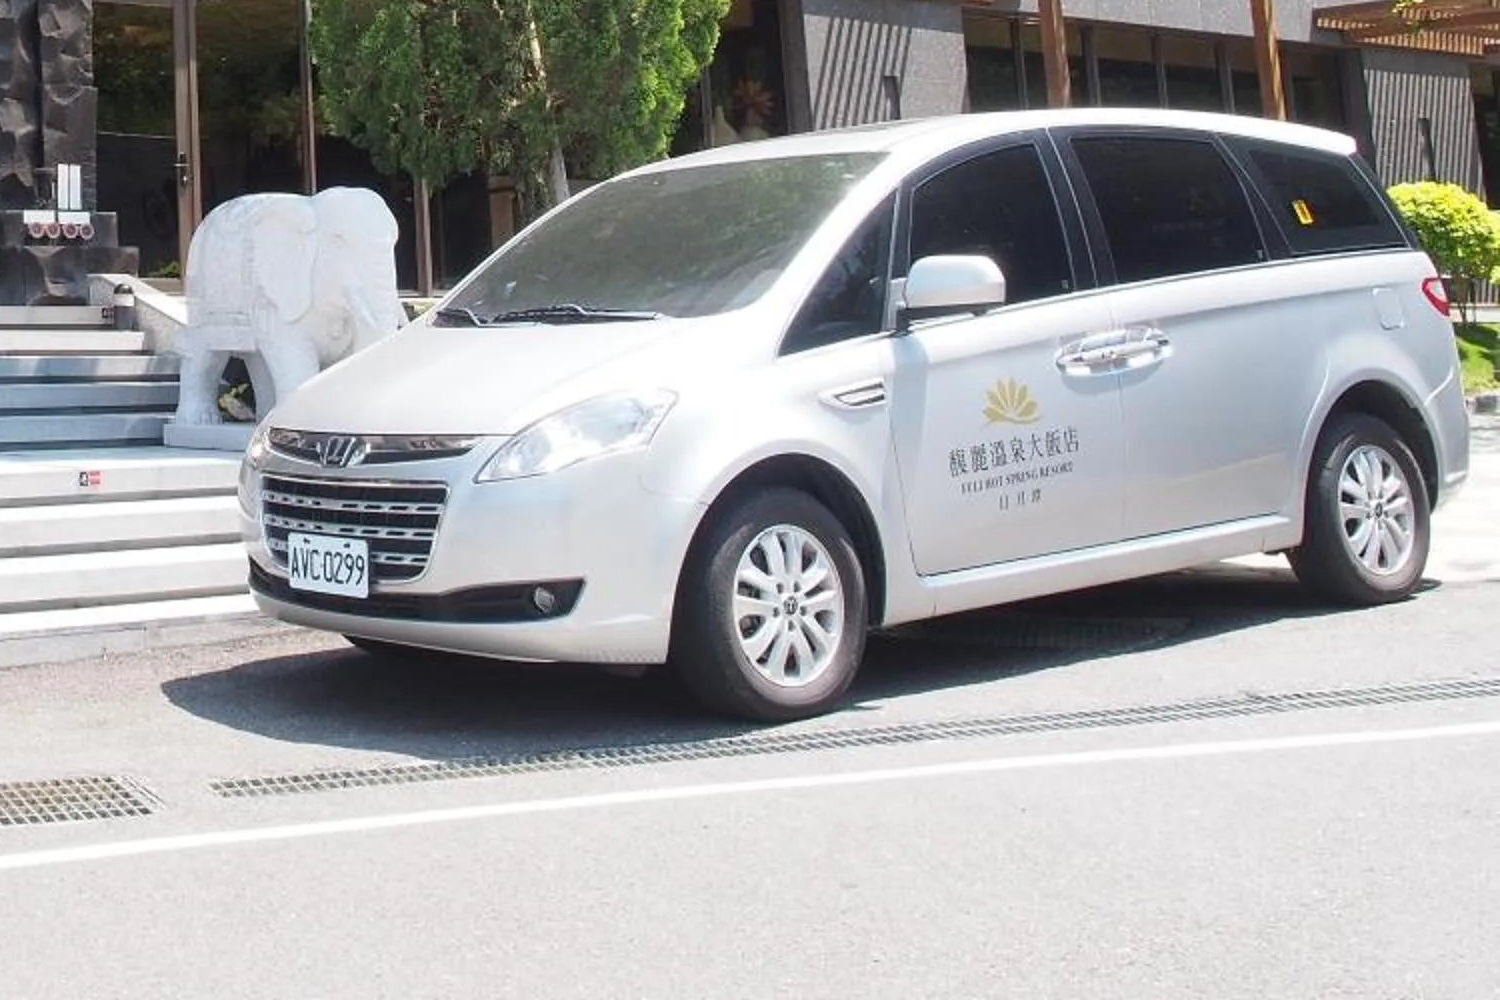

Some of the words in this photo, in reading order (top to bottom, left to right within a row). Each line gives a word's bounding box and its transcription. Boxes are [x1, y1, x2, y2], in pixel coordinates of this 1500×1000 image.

[985, 475, 1003, 489] HOT
[1005, 470, 1038, 486] SPRING
[1040, 461, 1074, 479] RESORT
